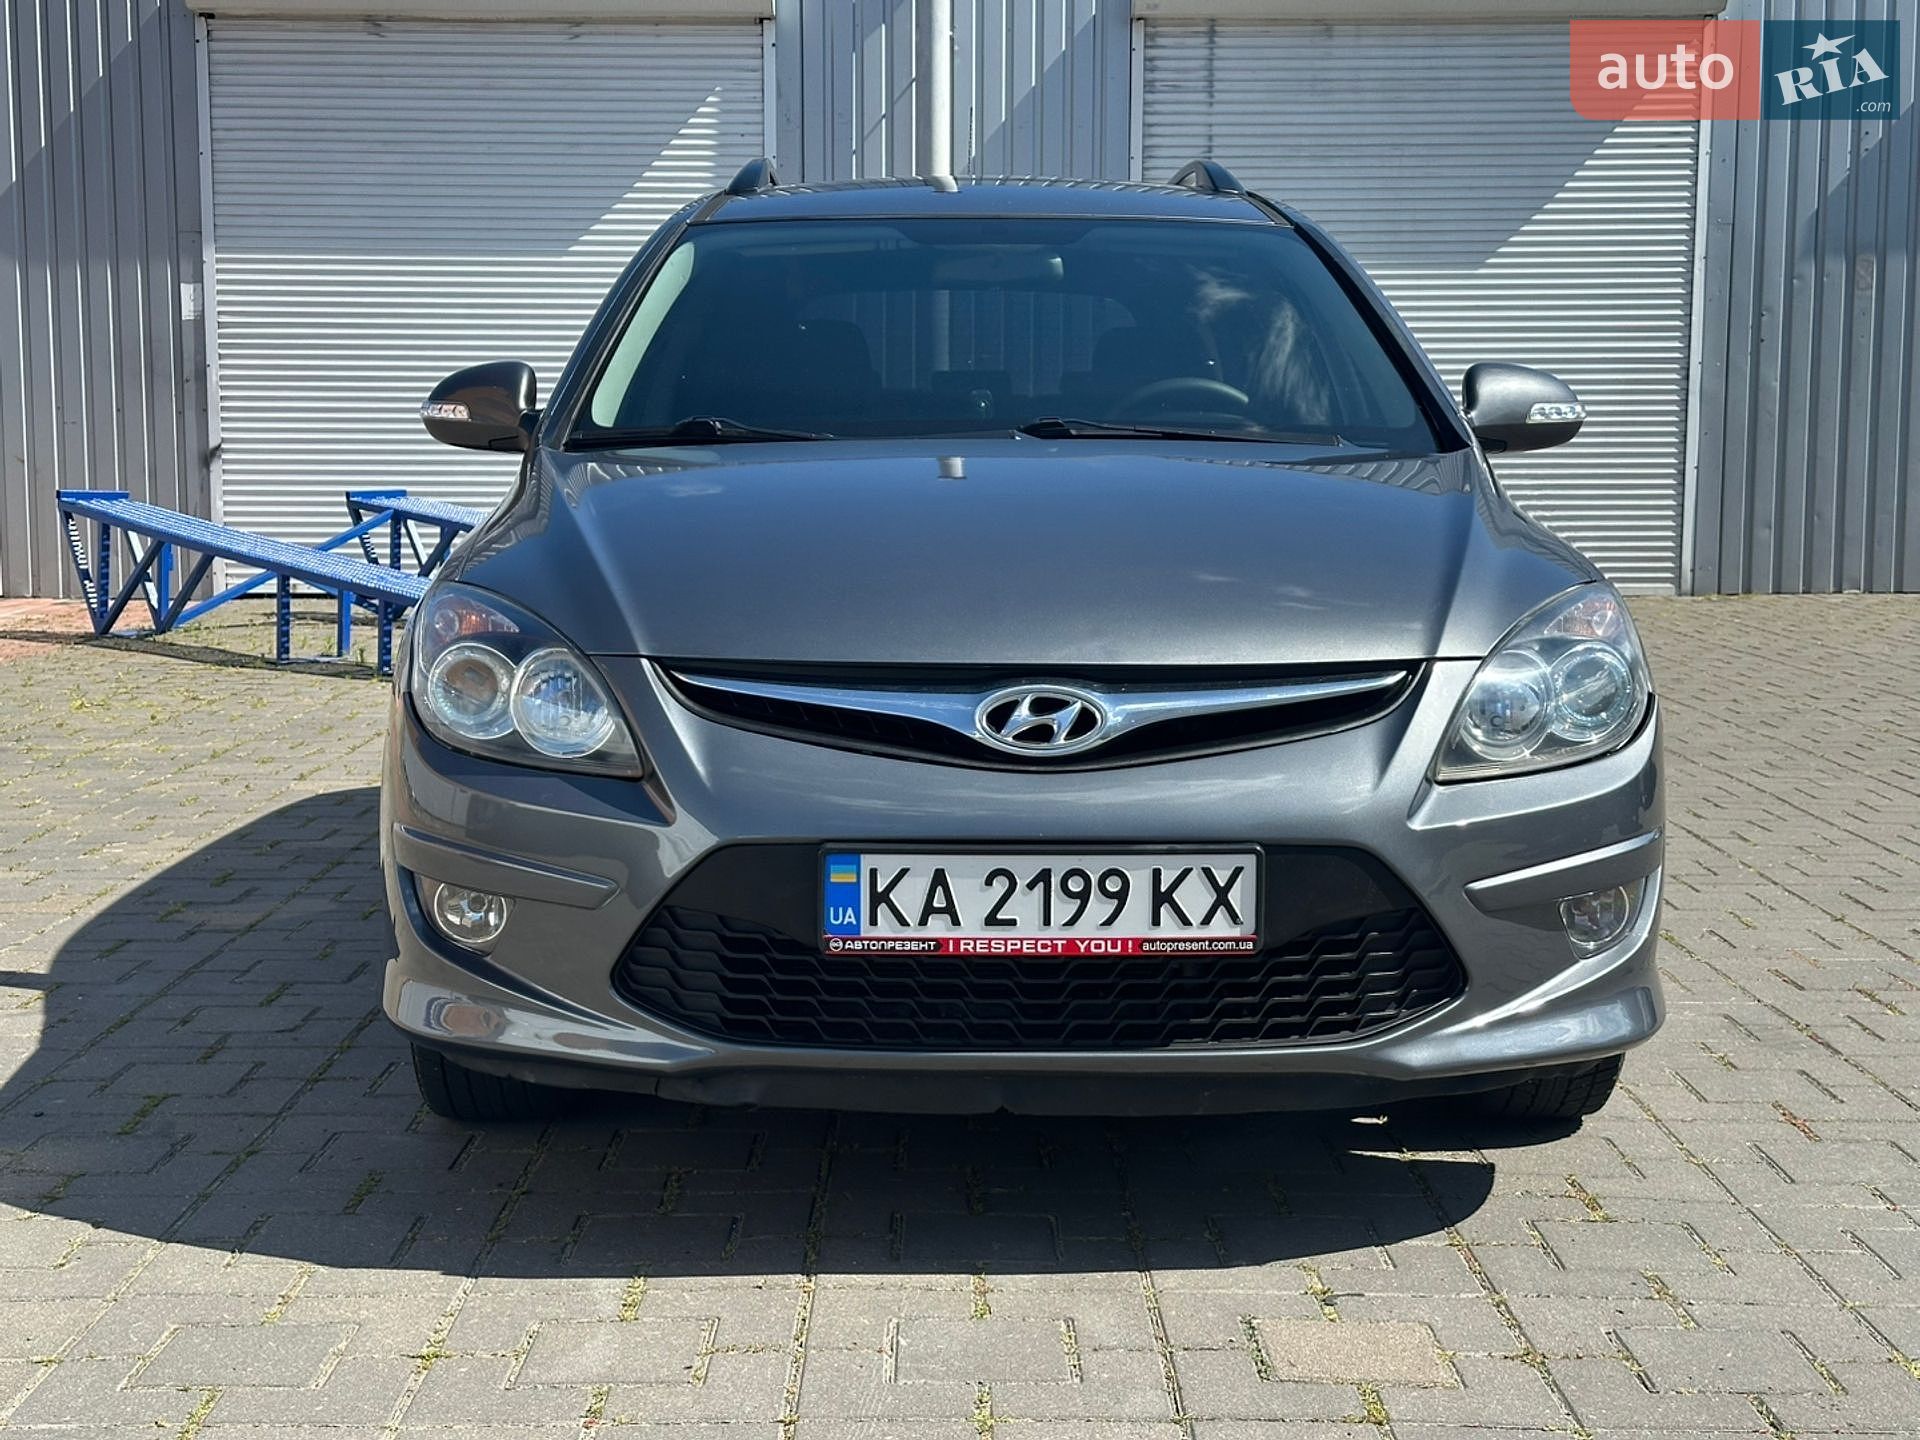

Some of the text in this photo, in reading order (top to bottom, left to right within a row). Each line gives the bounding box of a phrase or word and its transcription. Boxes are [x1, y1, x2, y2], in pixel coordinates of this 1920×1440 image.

[869, 866, 1245, 927] KA 2199 KX
[830, 907, 857, 925] UA
[844, 940, 937, 951] АВТОПРЕЗЕНТ
[959, 939, 1067, 953] RESPECT
[1142, 940, 1254, 953] autopresent.com.ua
